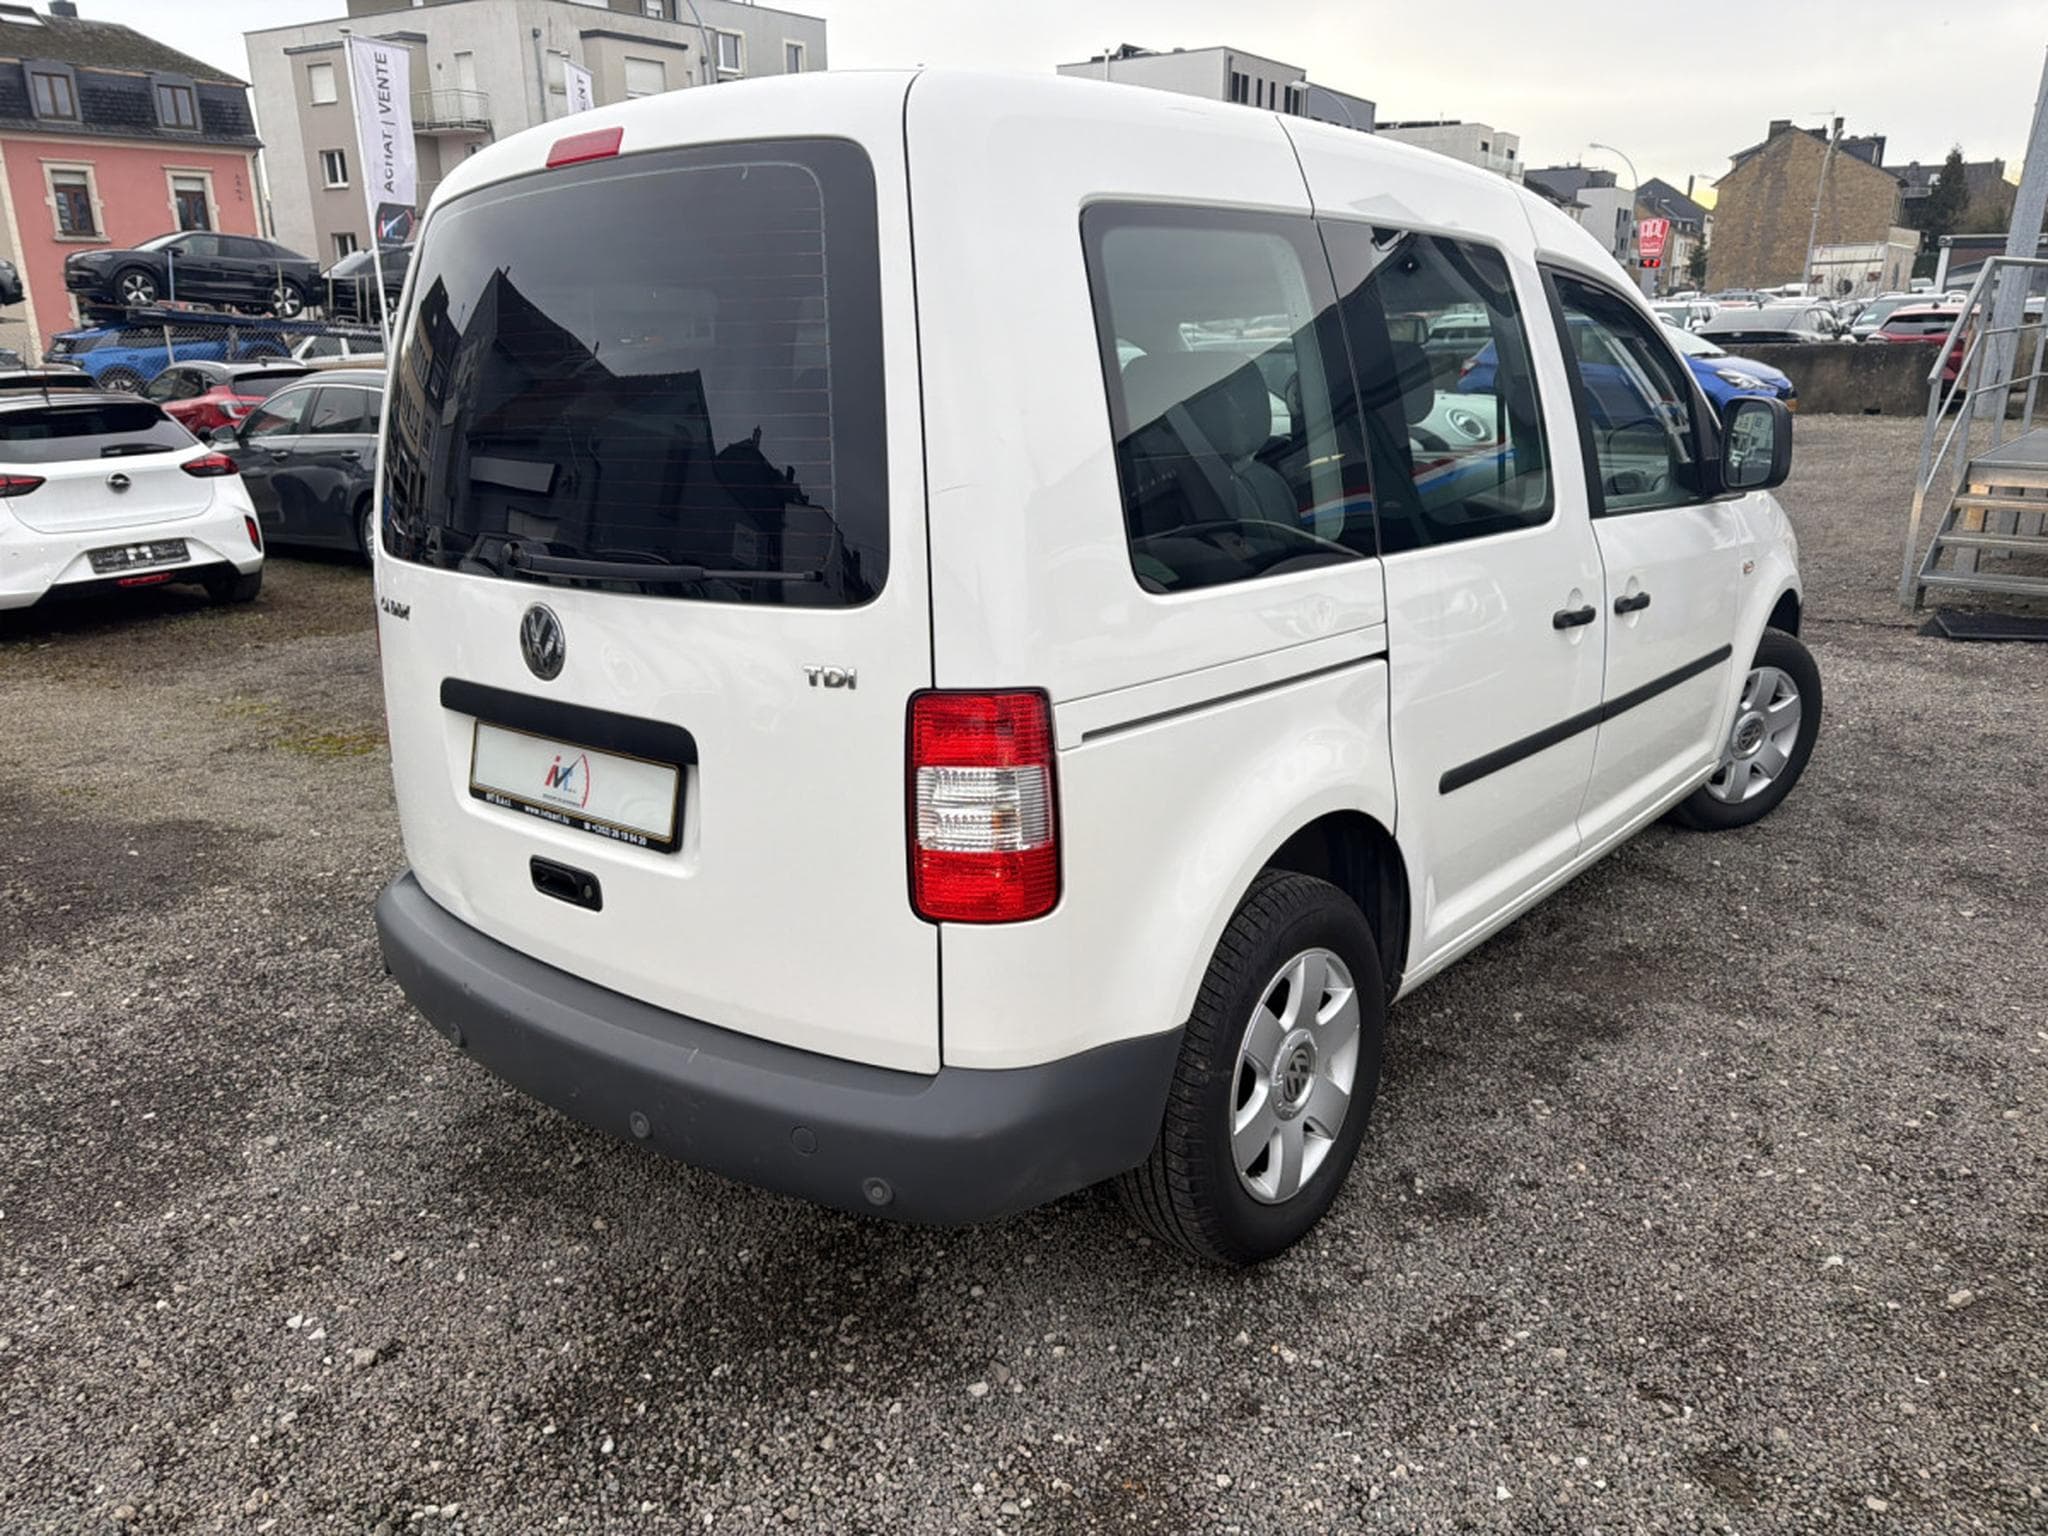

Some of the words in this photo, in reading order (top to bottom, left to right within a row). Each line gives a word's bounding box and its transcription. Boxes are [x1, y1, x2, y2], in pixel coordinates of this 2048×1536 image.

[374, 51, 392, 115] VENTE
[381, 131, 395, 194] ACHAT
[803, 665, 858, 691] TDI
